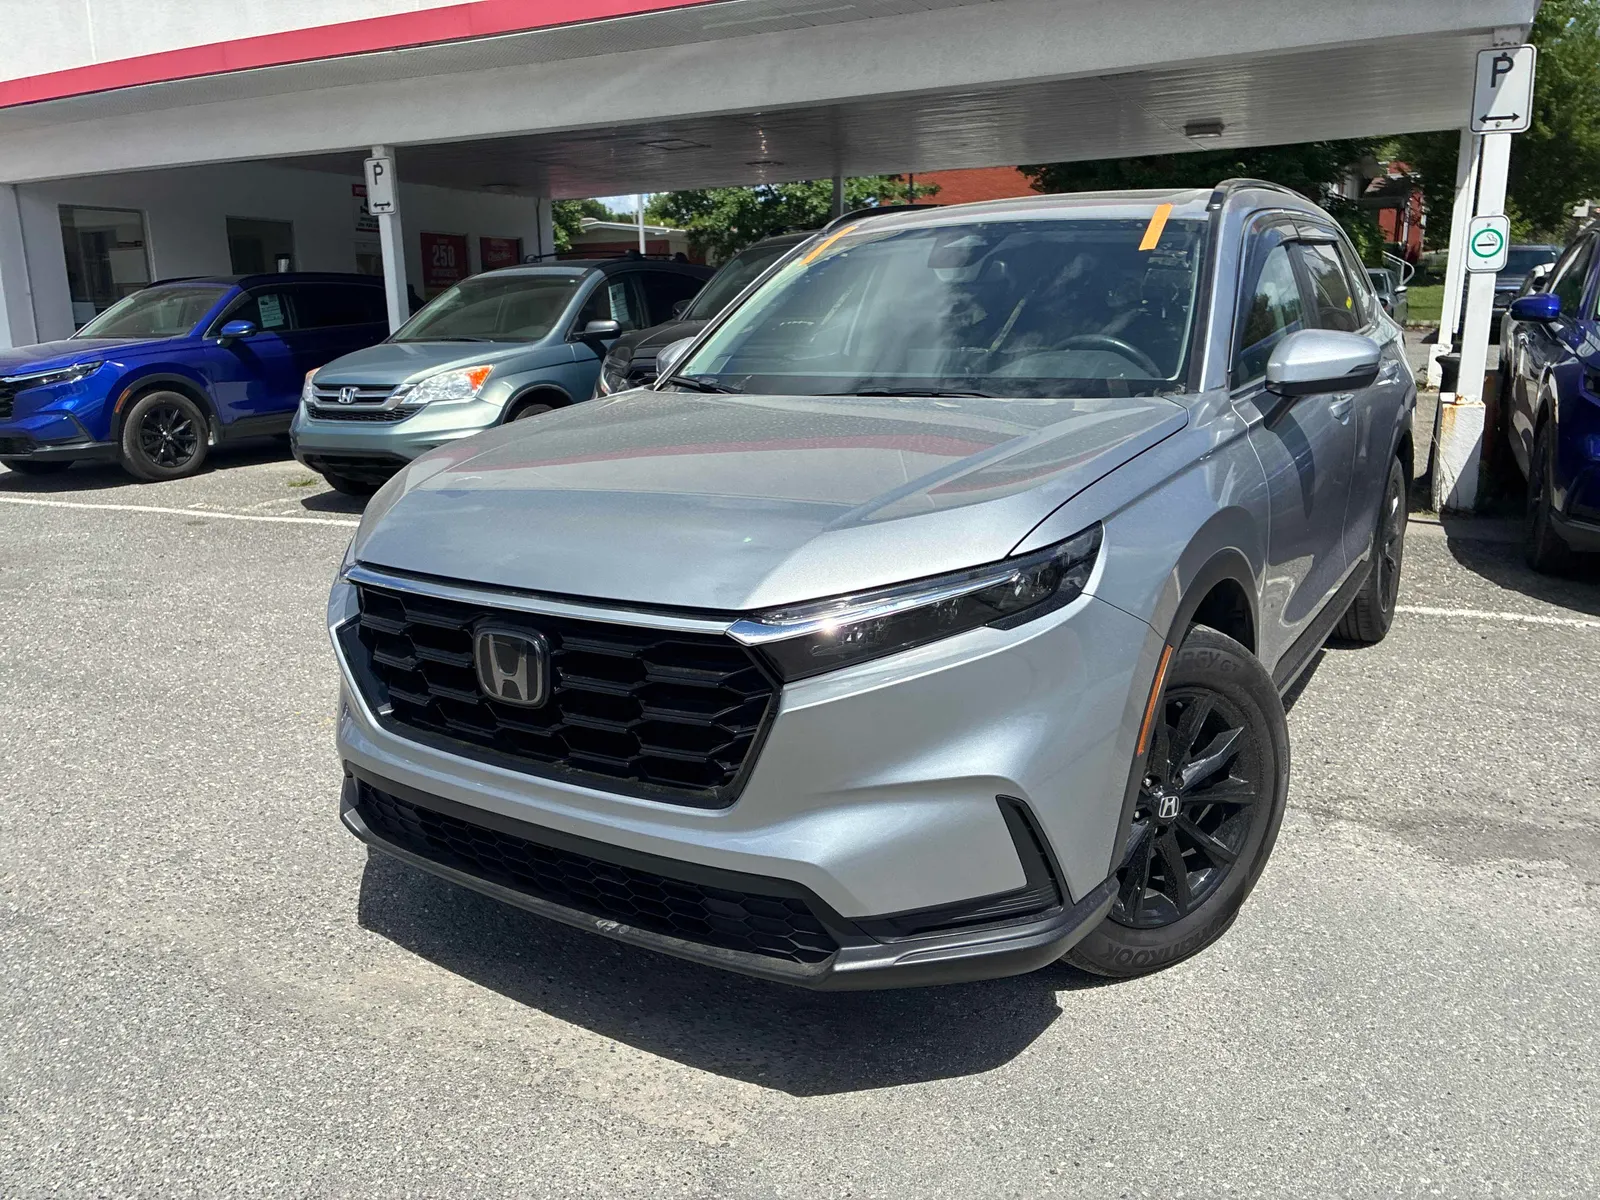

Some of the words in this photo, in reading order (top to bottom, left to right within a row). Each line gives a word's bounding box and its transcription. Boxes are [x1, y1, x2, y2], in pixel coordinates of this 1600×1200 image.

[1490, 56, 1514, 88] P
[372, 164, 384, 185] P
[432, 245, 455, 267] 250
